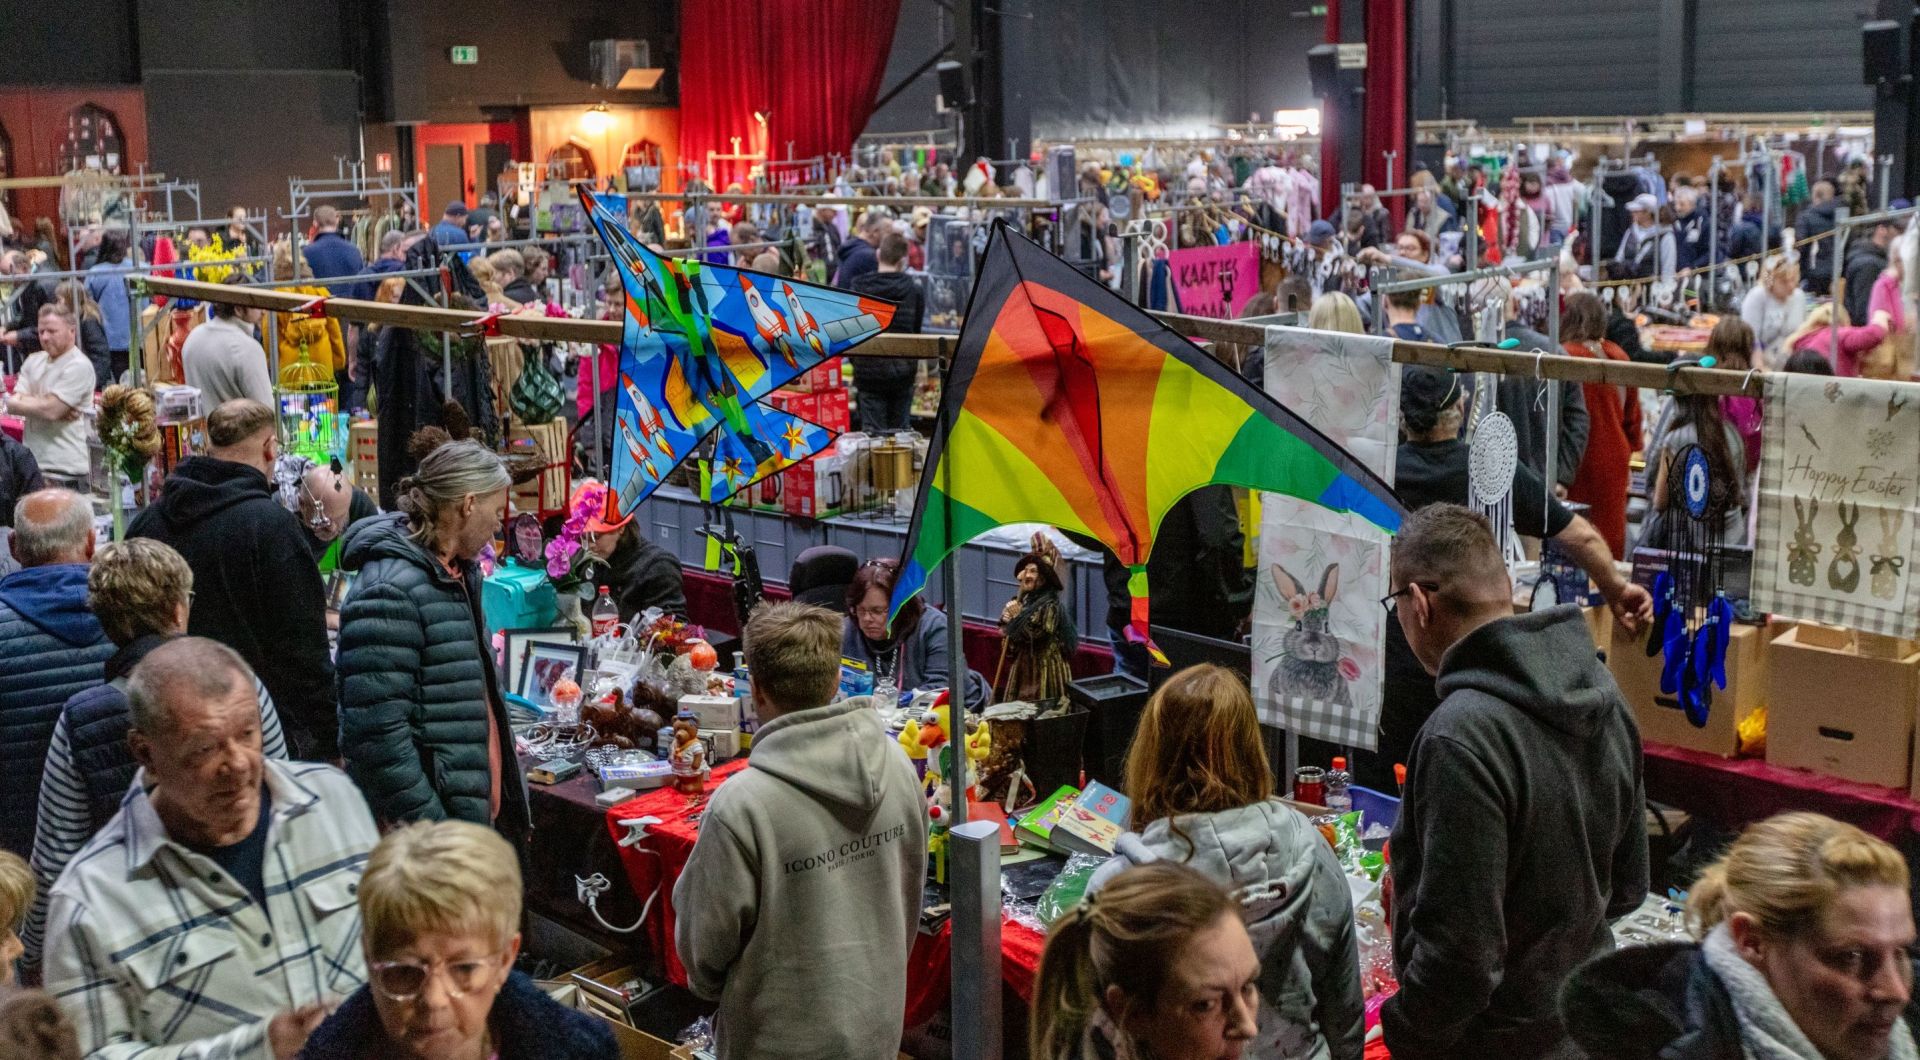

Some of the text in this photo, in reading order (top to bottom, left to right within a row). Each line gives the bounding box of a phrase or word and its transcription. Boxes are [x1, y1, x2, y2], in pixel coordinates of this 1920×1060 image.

[1788, 454, 1913, 503] Happy Easter
[784, 823, 905, 875] ICONO COUTURE
